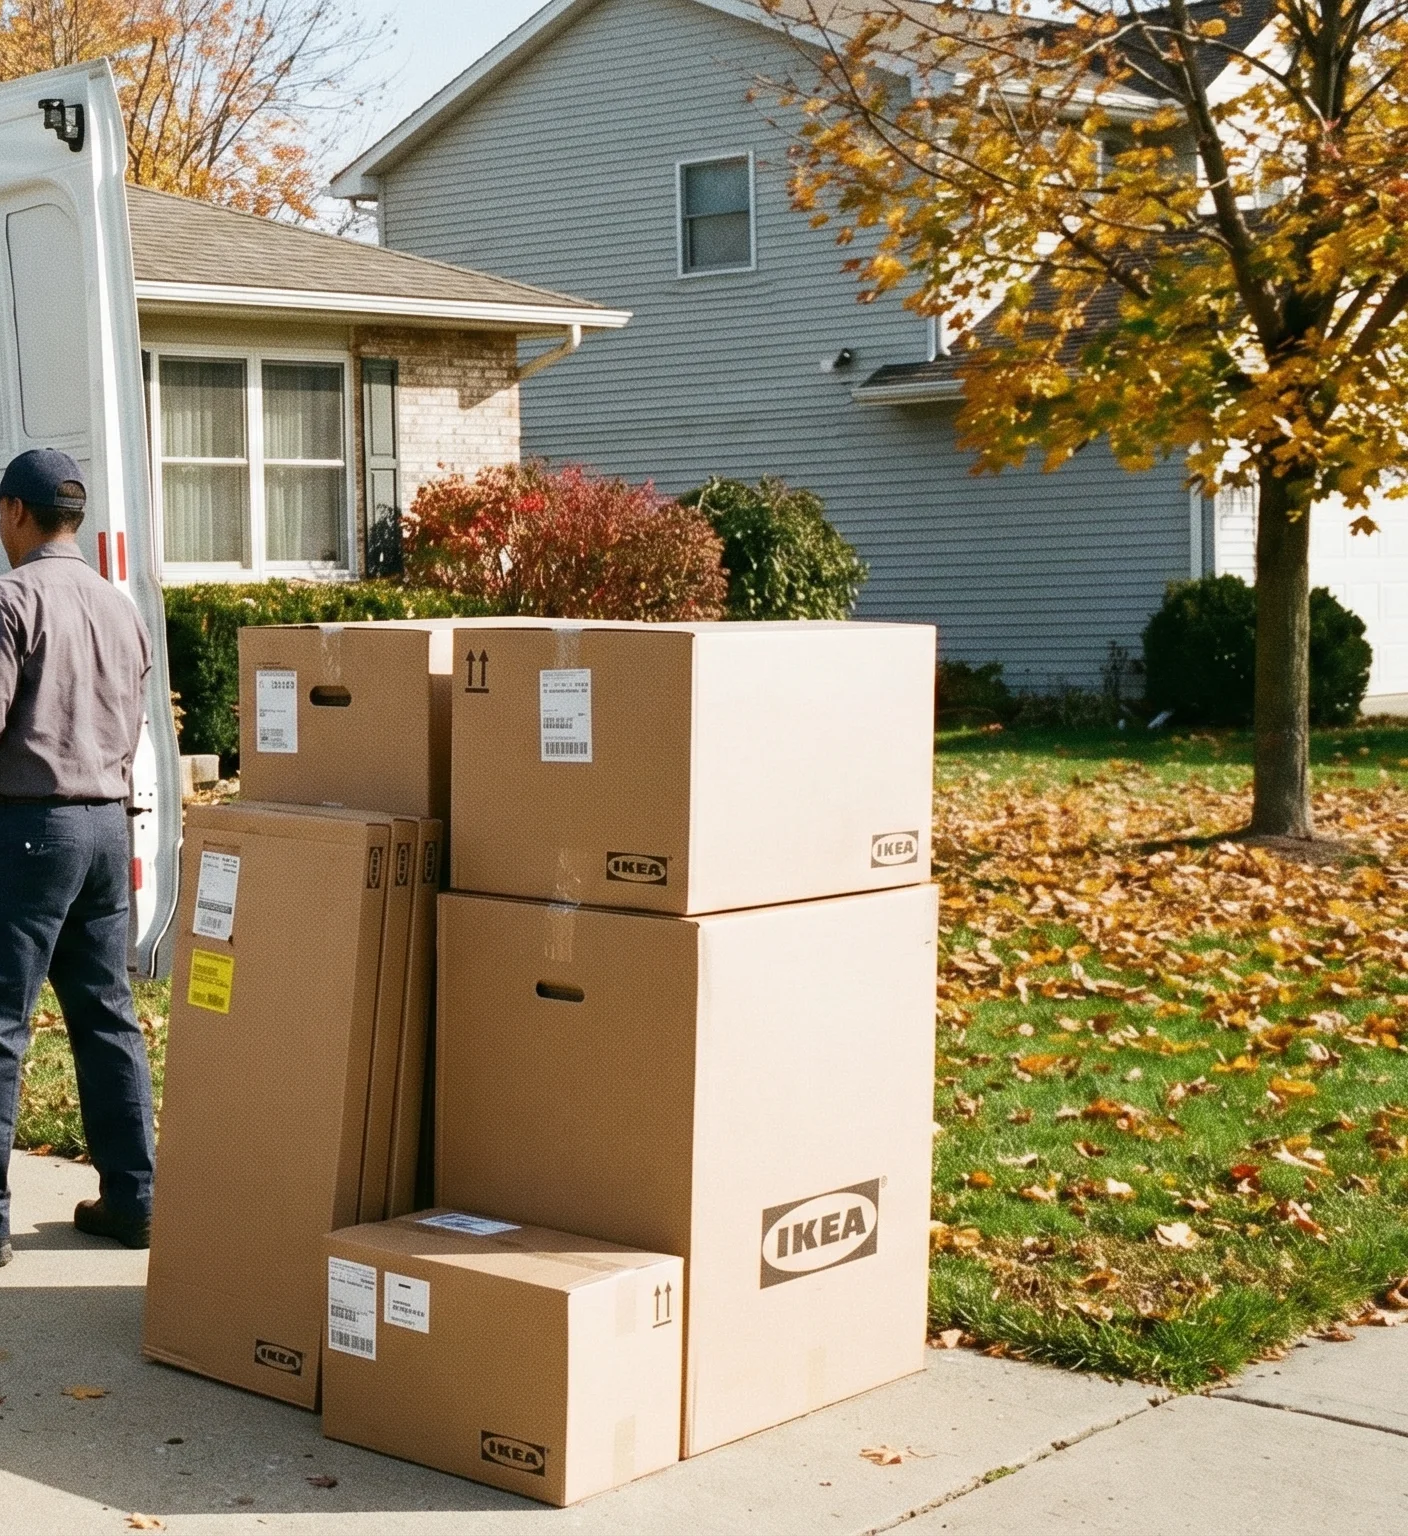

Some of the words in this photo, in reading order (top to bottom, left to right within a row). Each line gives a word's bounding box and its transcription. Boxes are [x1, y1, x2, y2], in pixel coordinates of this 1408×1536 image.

[877, 840, 914, 857] IKEA
[613, 860, 662, 876] IKEA
[777, 1206, 867, 1259] IKEA
[489, 1440, 539, 1466] IKEA
